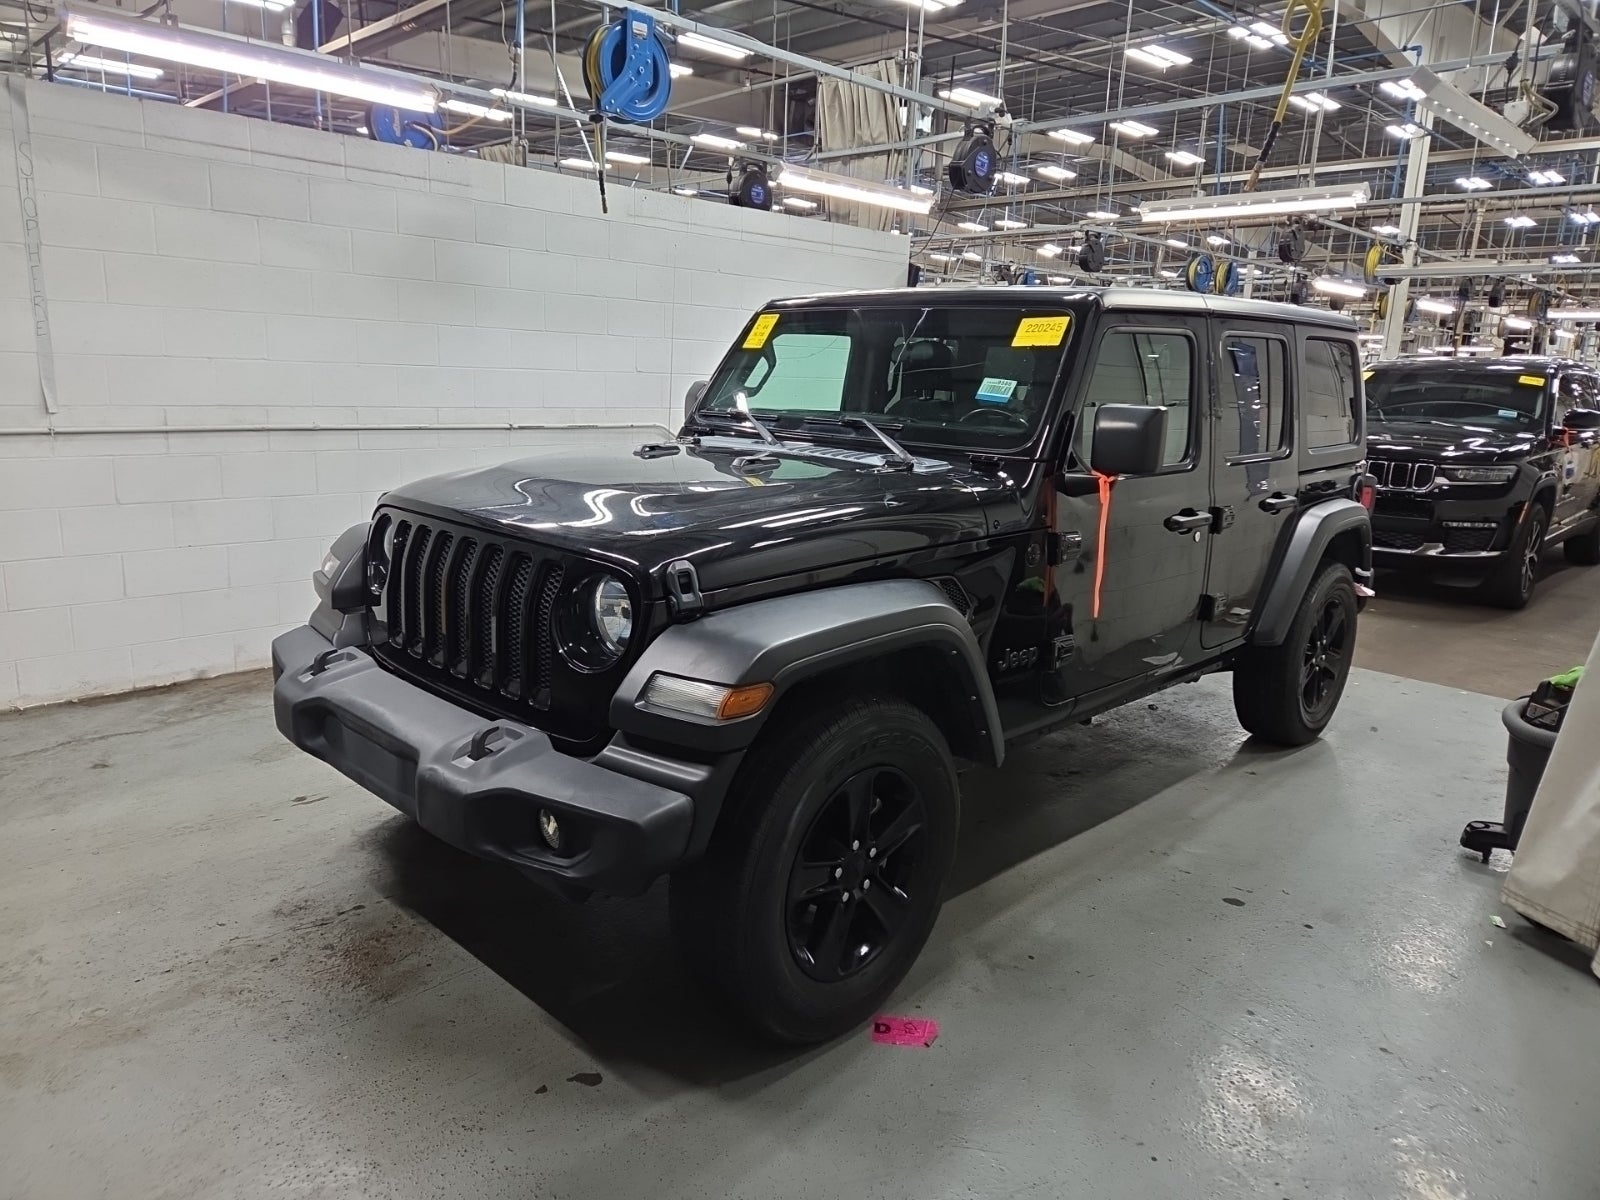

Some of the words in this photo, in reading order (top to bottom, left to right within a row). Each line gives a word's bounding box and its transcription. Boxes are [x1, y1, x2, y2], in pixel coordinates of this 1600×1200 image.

[19, 142, 39, 236] STOP
[28, 243, 48, 337] HERE
[1025, 322, 1064, 333] 220245
[998, 646, 1039, 671] Jeep
